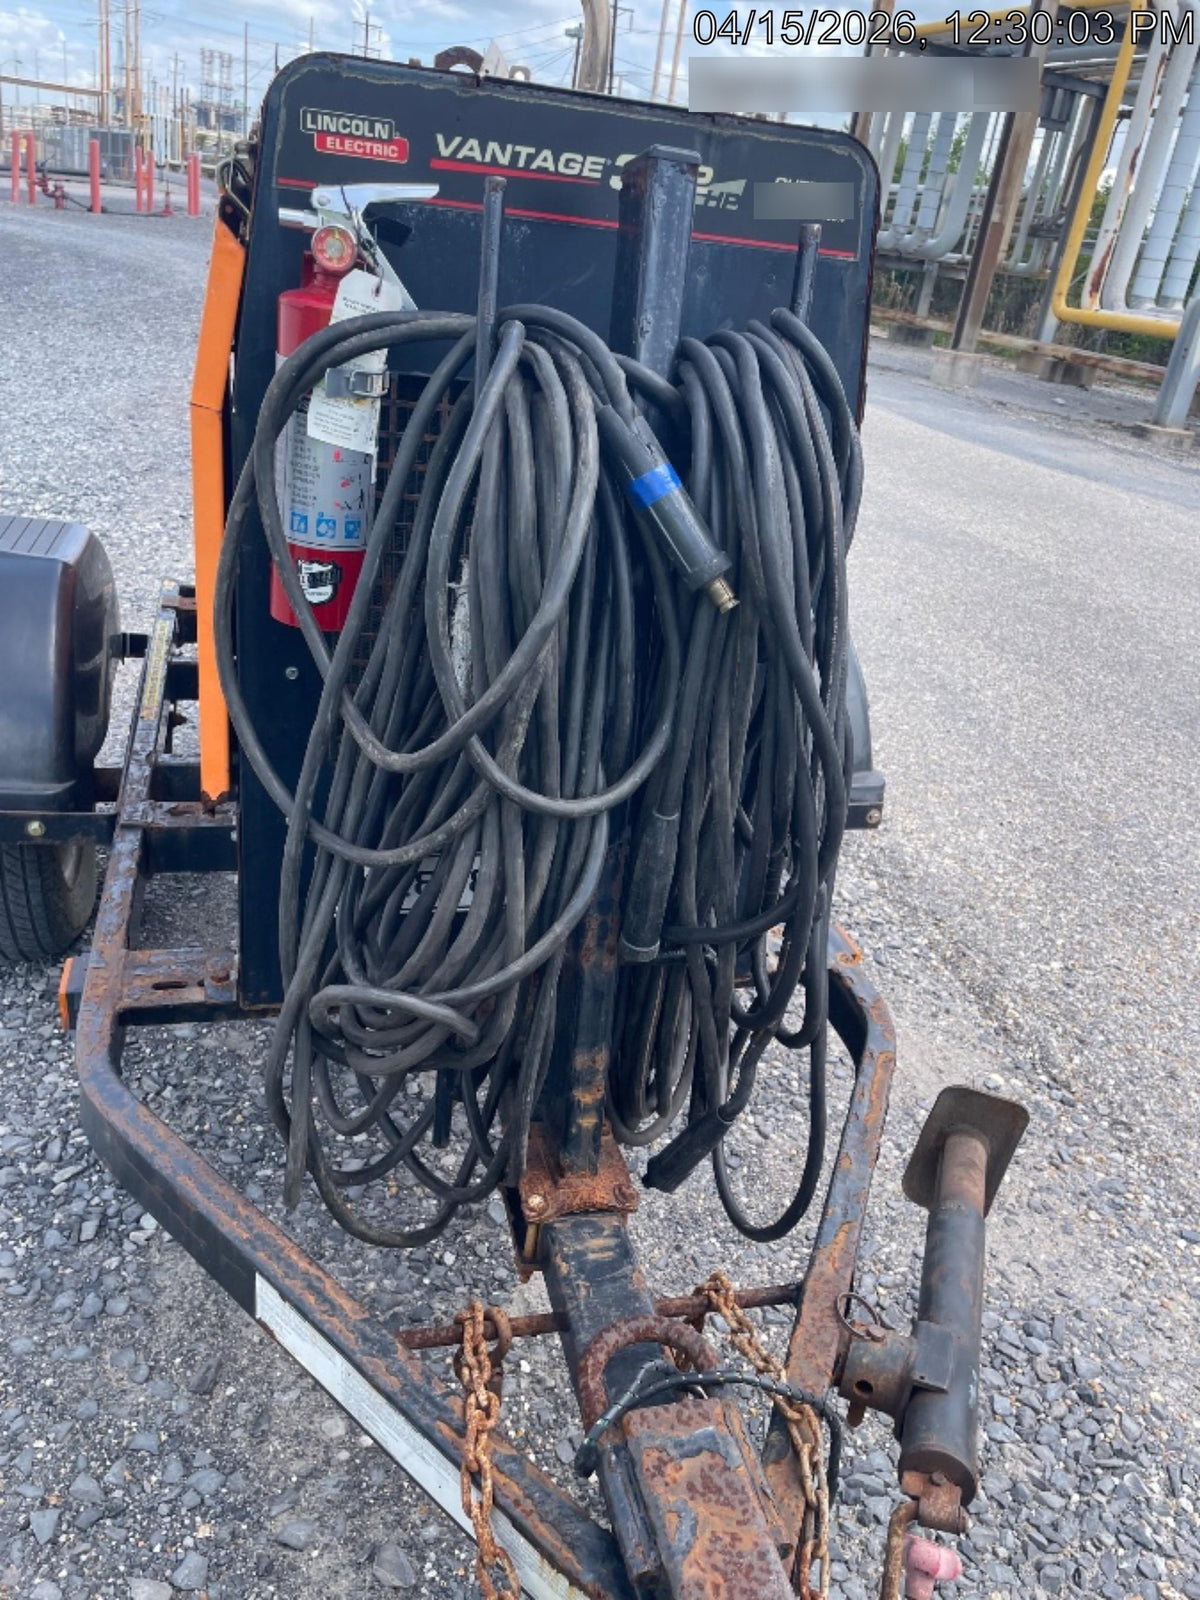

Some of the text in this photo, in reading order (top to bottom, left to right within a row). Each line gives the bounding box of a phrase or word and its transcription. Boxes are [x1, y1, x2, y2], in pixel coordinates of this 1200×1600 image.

[306, 112, 389, 139] LINCOLN
[326, 136, 399, 158] ELECTRIC
[435, 132, 607, 179] VANTAGE
